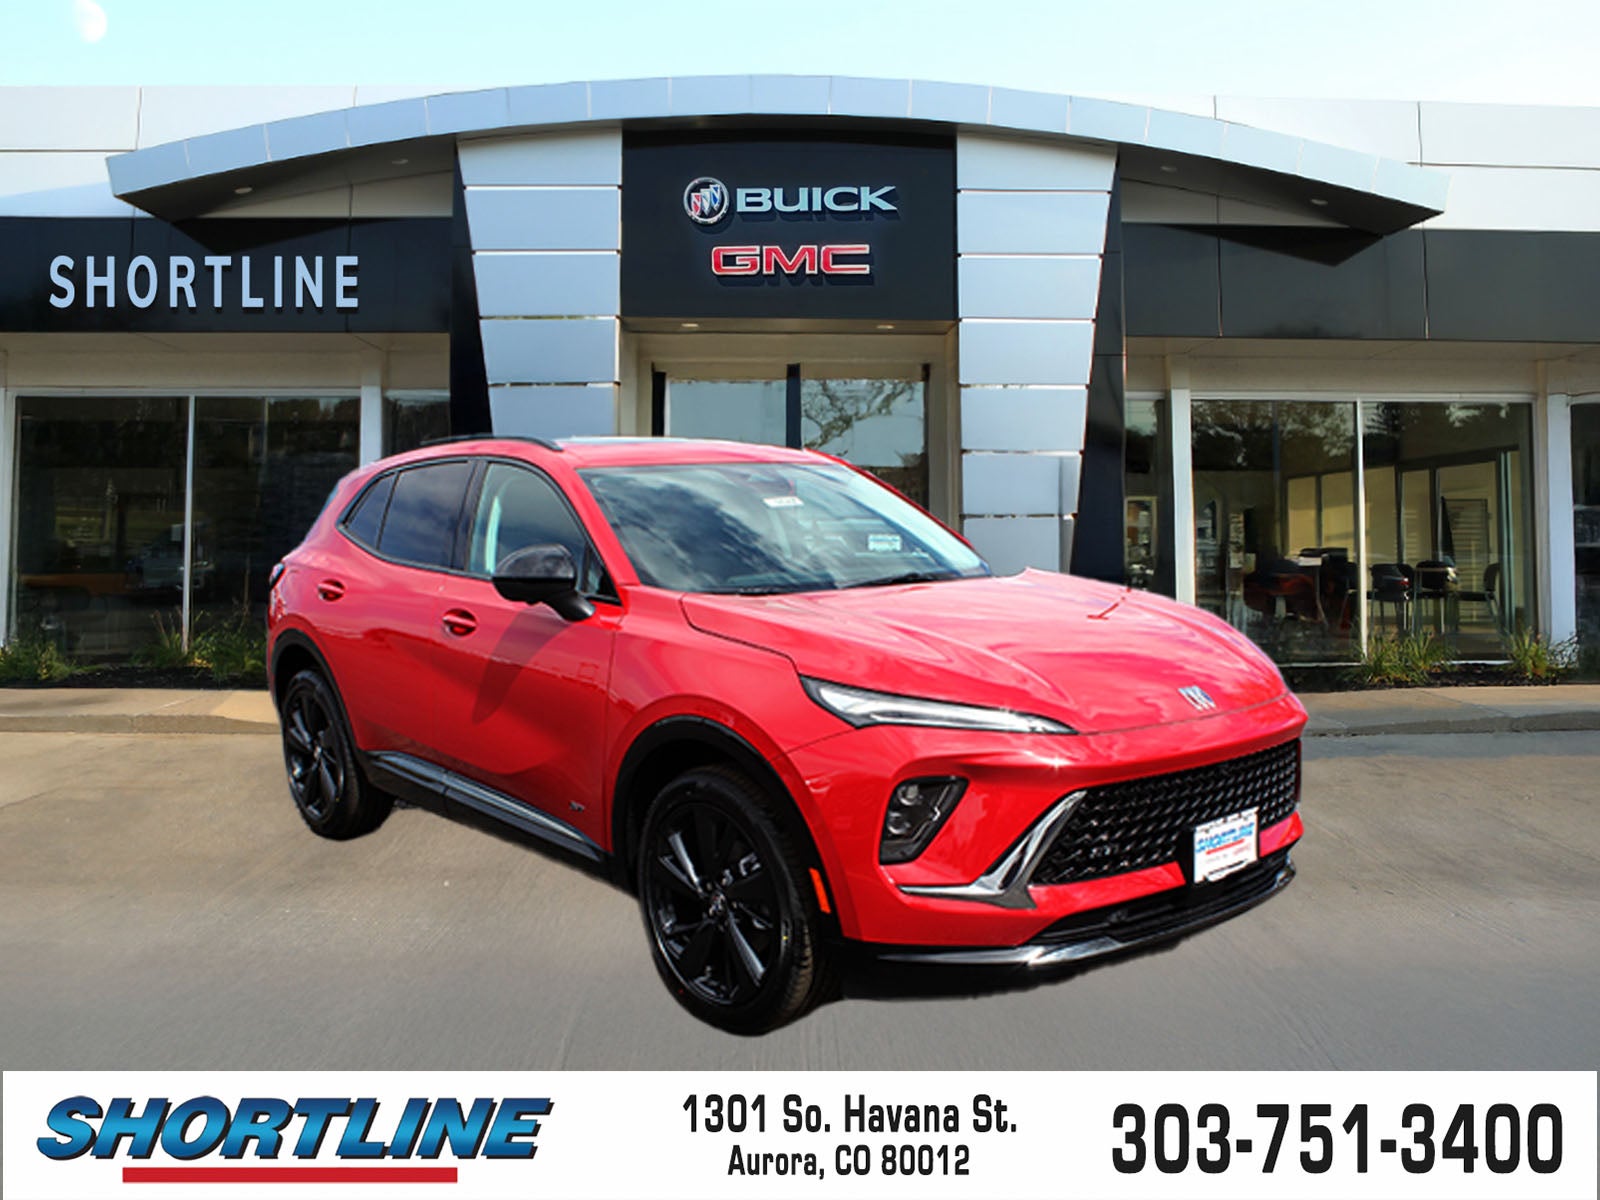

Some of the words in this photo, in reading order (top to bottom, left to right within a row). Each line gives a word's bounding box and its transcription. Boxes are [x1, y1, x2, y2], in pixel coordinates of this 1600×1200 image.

[736, 186, 898, 213] BUICK
[711, 244, 870, 275] GMC
[49, 255, 359, 308] SHORTLINE
